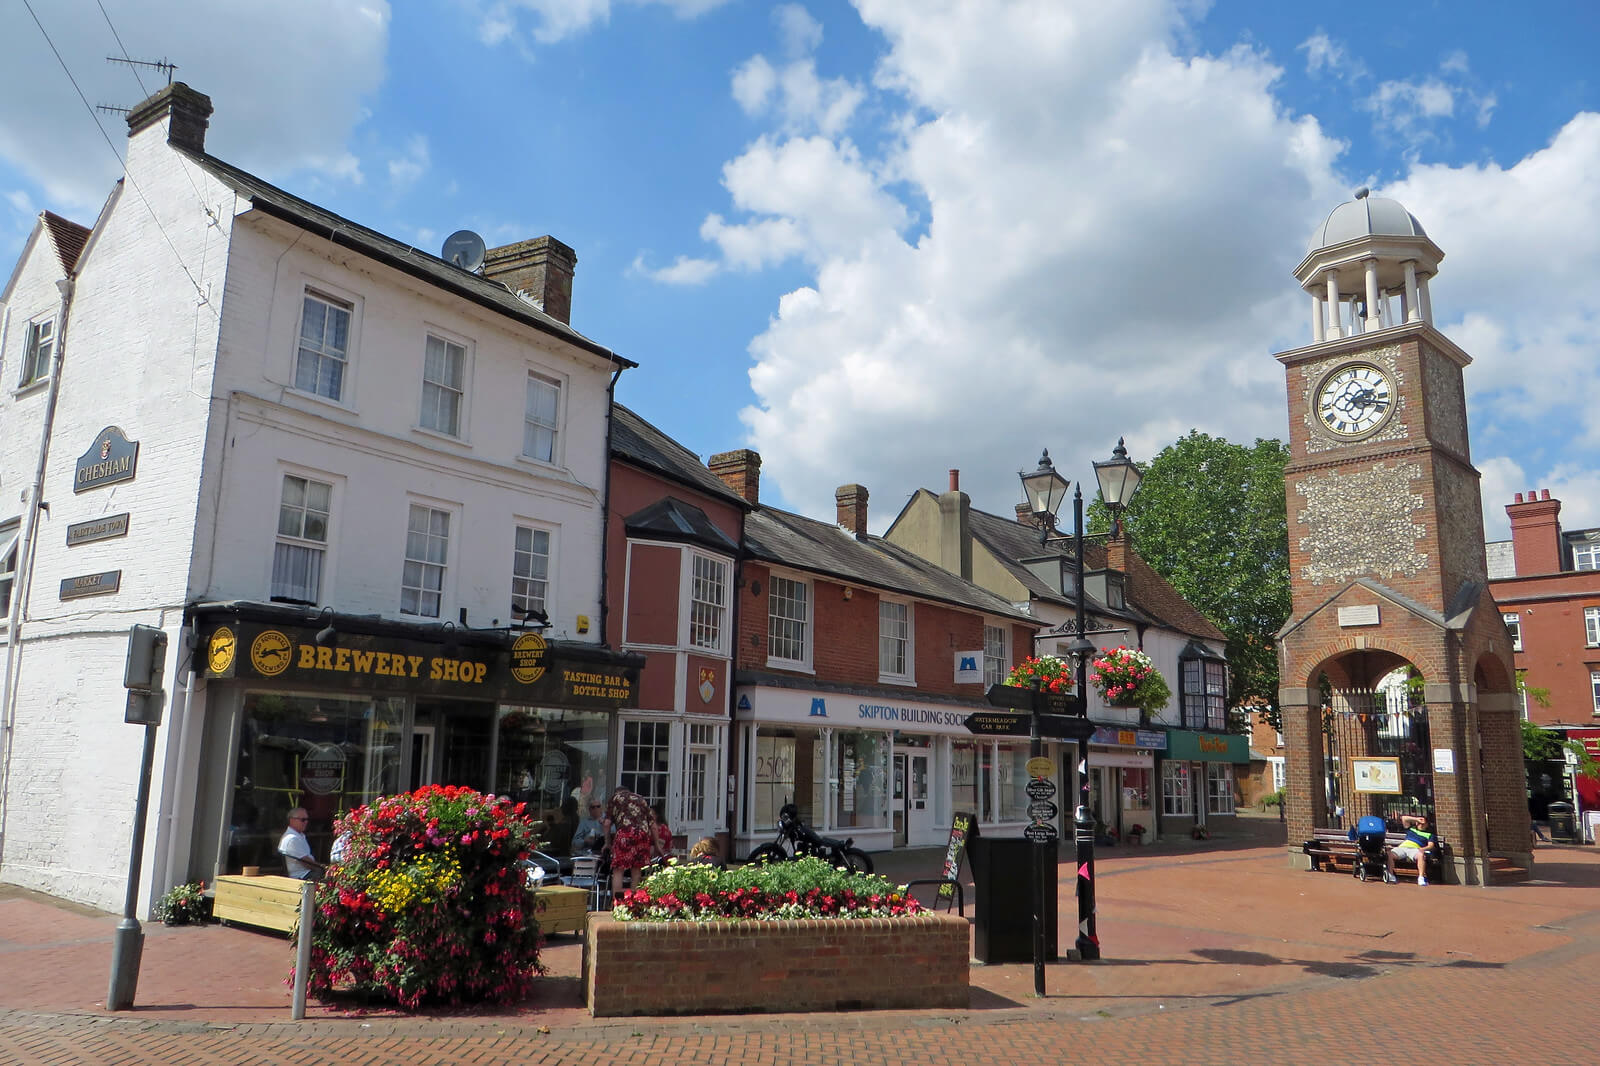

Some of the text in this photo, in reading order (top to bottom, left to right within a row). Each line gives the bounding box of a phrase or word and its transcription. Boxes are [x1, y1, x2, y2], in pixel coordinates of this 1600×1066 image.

[77, 456, 131, 484] CHESHAM
[298, 644, 487, 684] BREWERY SHOP
[514, 651, 544, 659] BREWERY
[563, 671, 630, 687] TASTING BAR &
[573, 684, 630, 699] BOTTLE SHOP
[859, 704, 899, 721] SKIPTON
[901, 708, 943, 725] BUILDING
